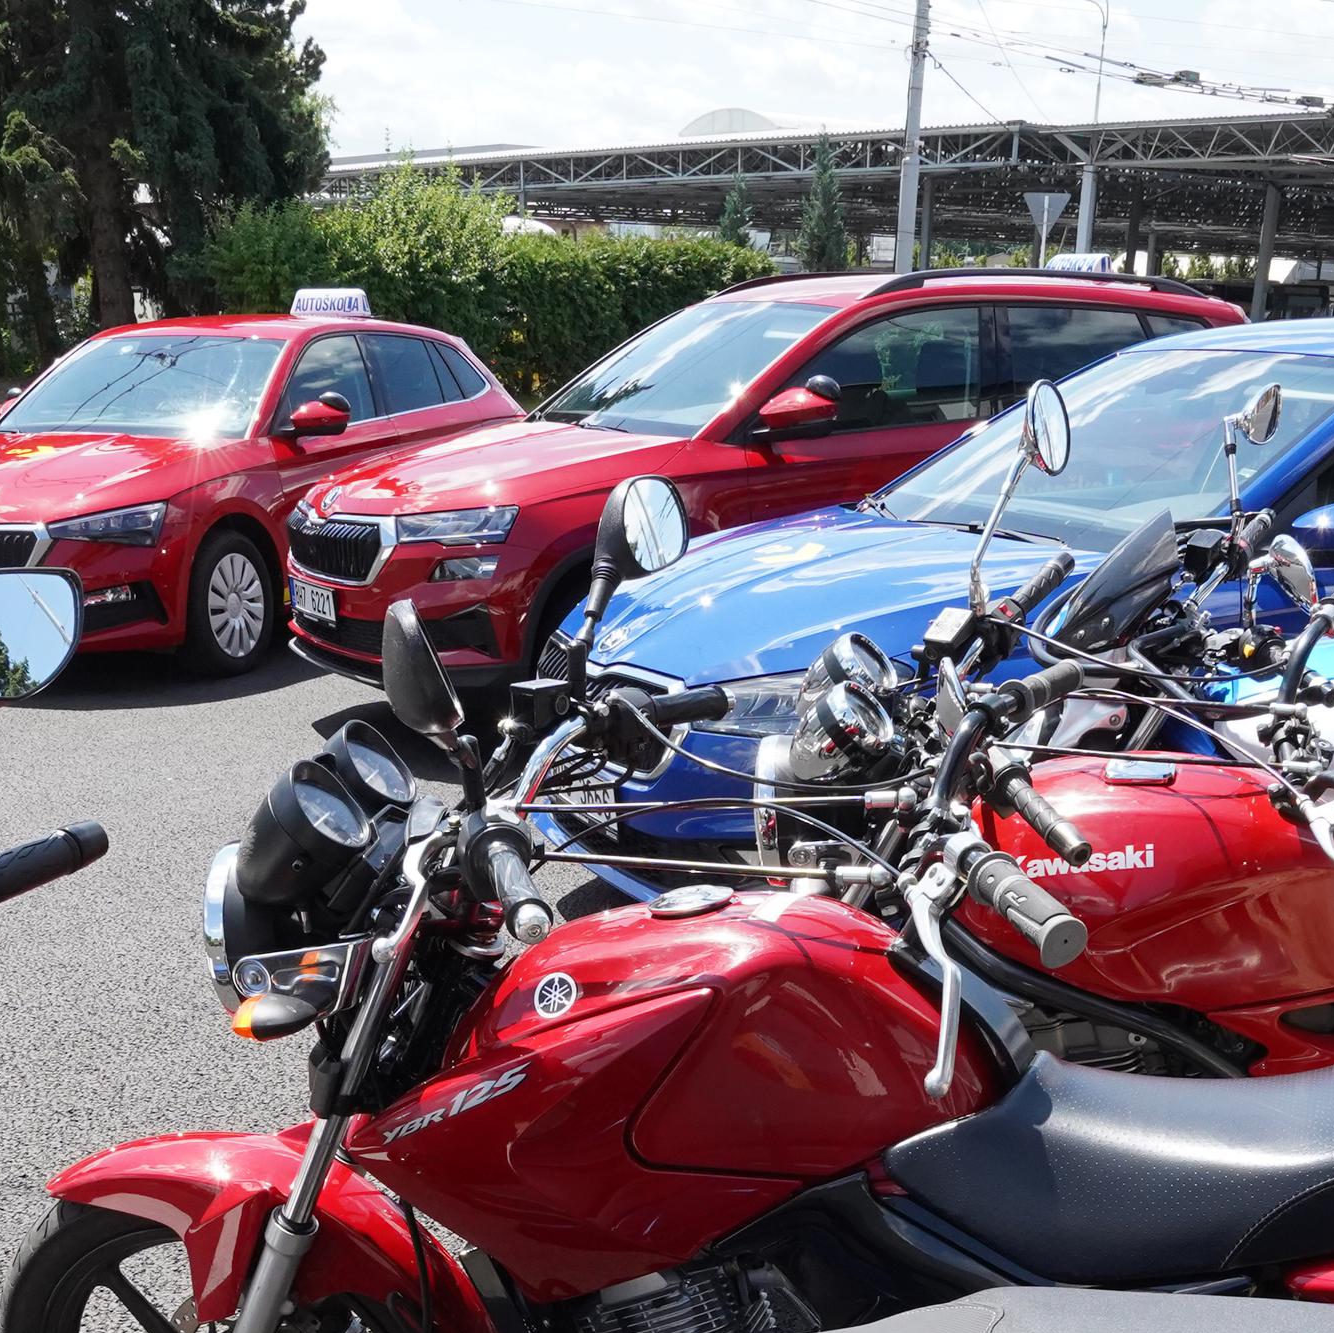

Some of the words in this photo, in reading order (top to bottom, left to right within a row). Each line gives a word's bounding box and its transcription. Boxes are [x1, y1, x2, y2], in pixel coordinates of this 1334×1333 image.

[295, 294, 359, 313] AUTOŠKOLA
[311, 589, 332, 617] 6221
[1015, 843, 1155, 879] awsaki
[383, 1107, 447, 1146] YBR
[448, 1061, 532, 1118] 125
